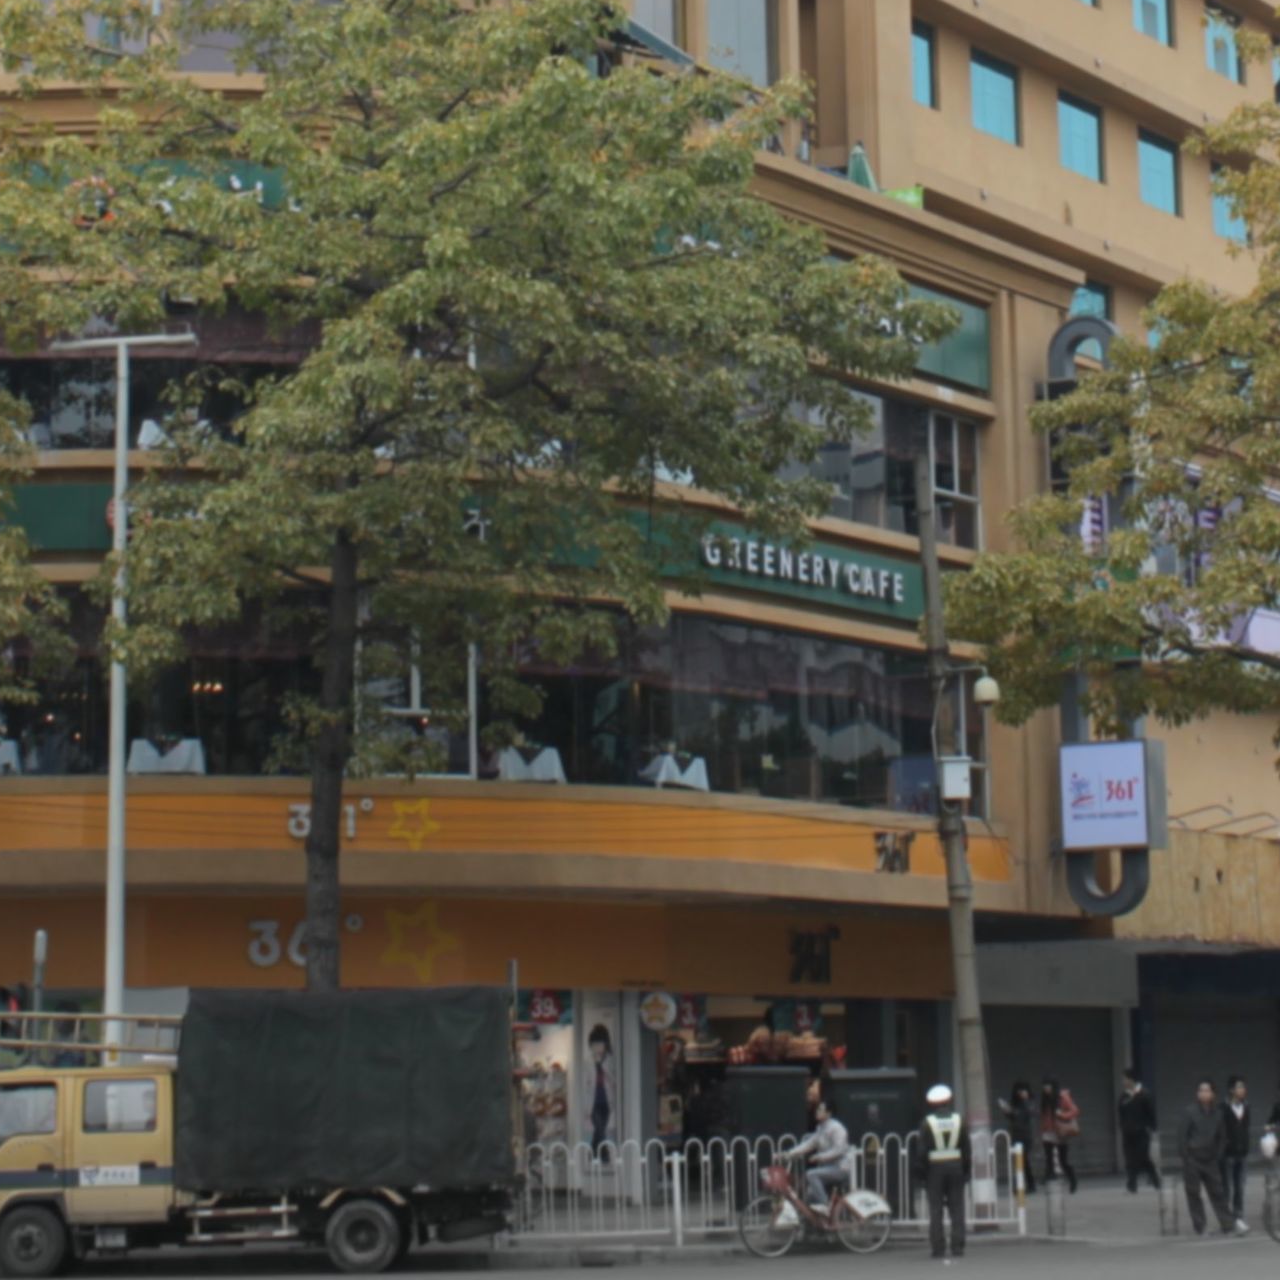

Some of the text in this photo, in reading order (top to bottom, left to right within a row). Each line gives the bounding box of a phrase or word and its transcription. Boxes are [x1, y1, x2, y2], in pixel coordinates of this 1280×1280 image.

[702, 534, 904, 603] GREENERY CAFE
[287, 797, 374, 839] 31°
